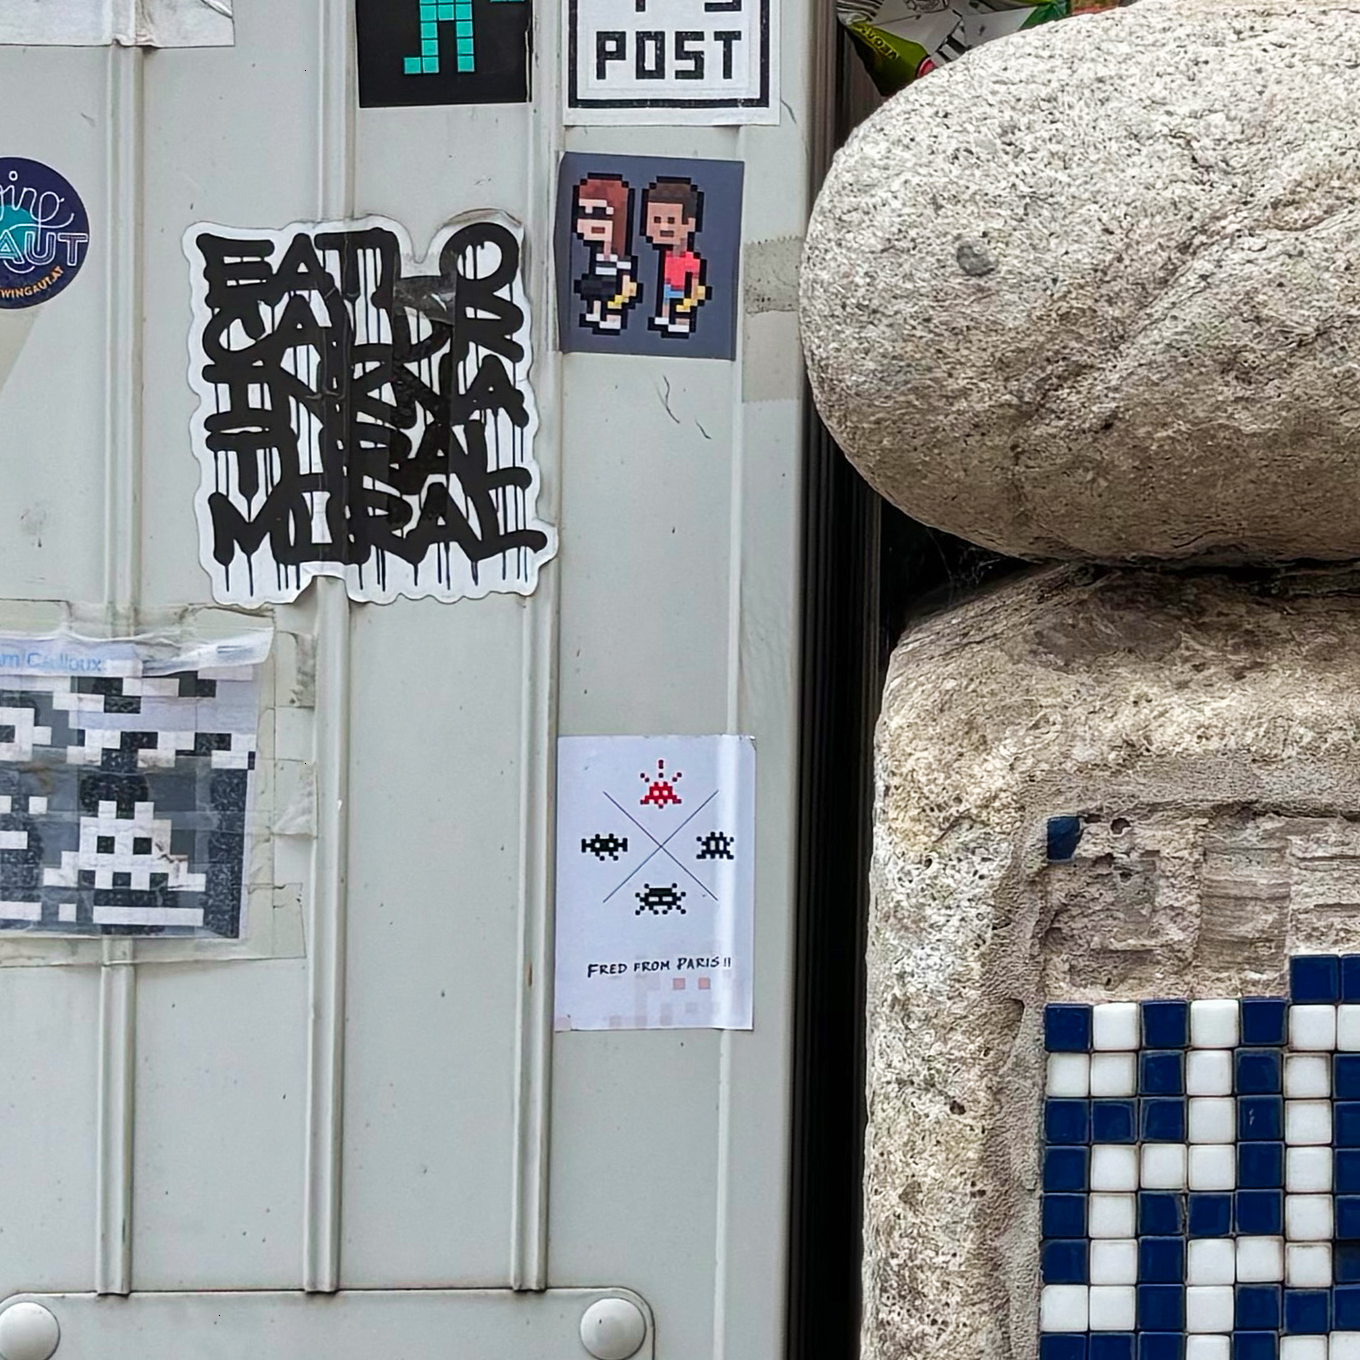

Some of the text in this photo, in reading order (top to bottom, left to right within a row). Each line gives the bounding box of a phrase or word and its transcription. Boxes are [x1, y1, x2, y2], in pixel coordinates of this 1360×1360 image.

[596, 30, 742, 80] POST
[586, 962, 628, 979] FRED
[633, 959, 671, 973] FROM
